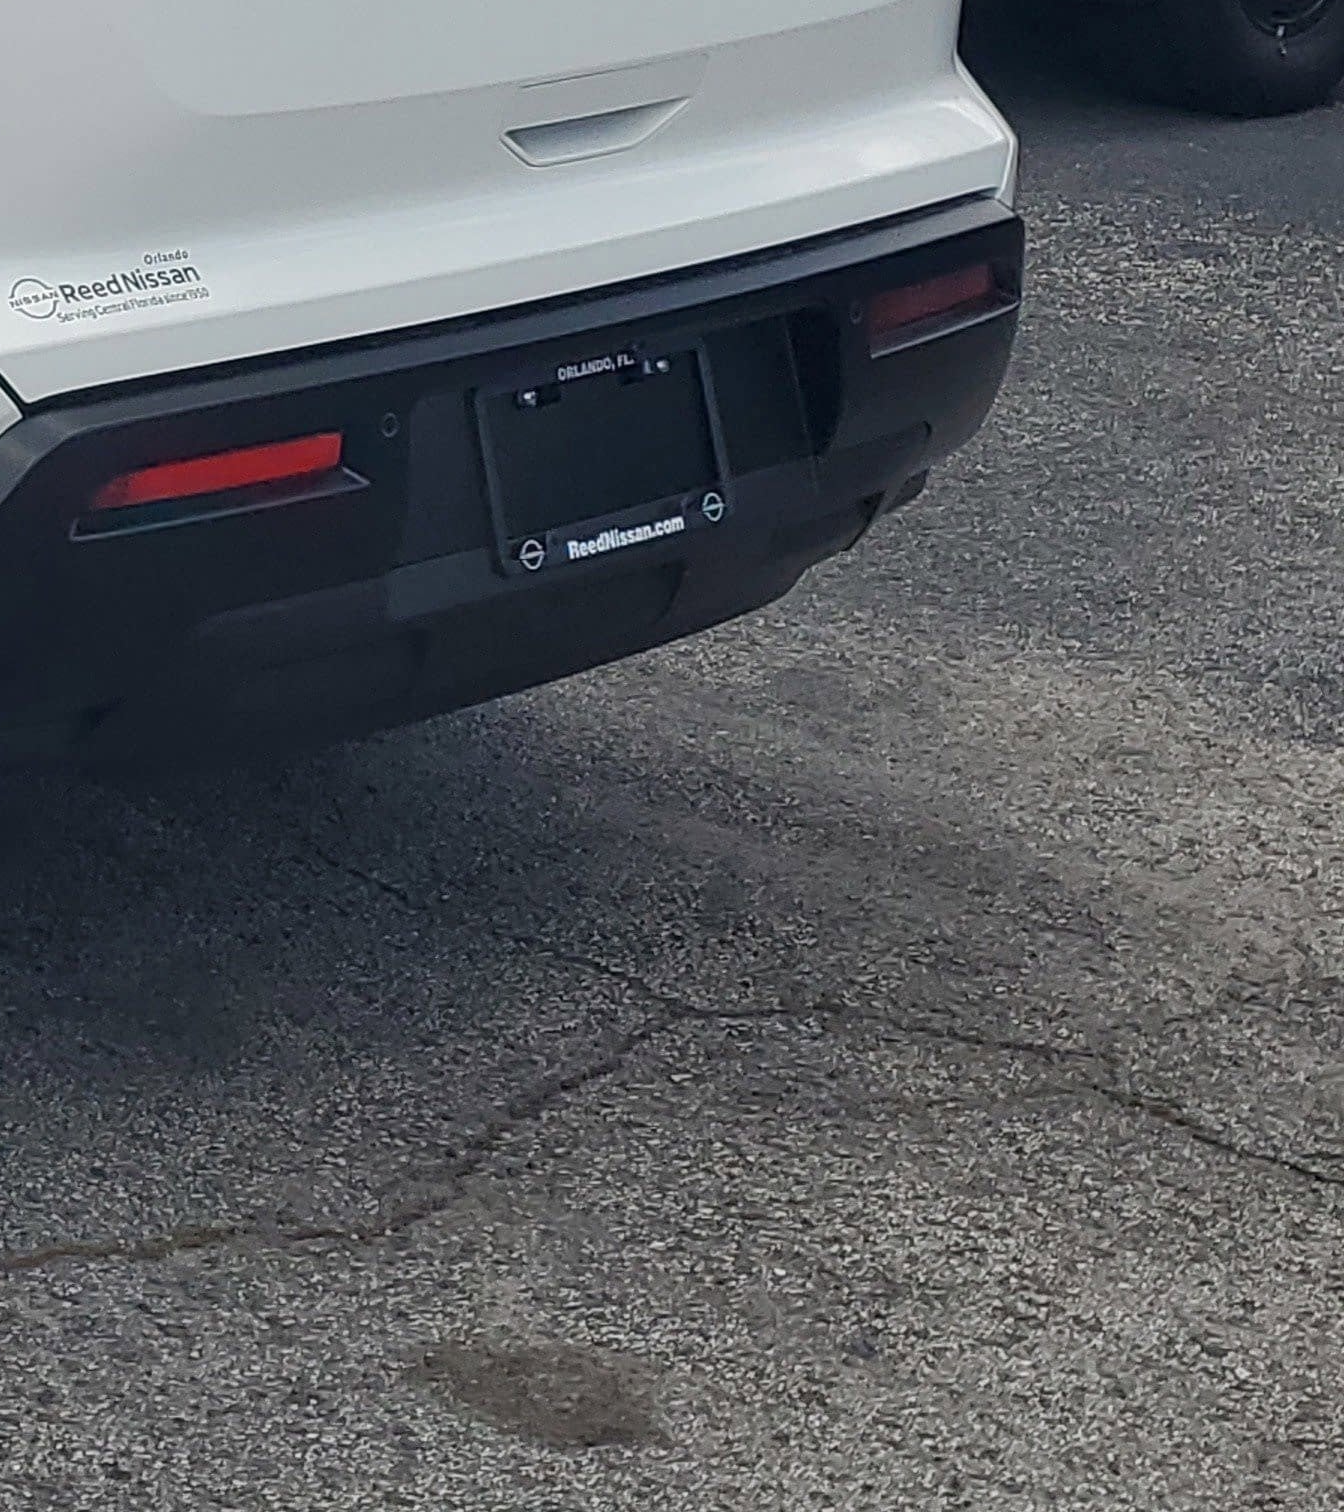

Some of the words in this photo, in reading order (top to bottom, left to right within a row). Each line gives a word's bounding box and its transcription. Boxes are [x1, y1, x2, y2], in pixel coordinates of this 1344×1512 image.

[143, 249, 190, 266] Orlando
[557, 356, 616, 381] ORLANDO,
[566, 515, 686, 560] ReedNissan.com
